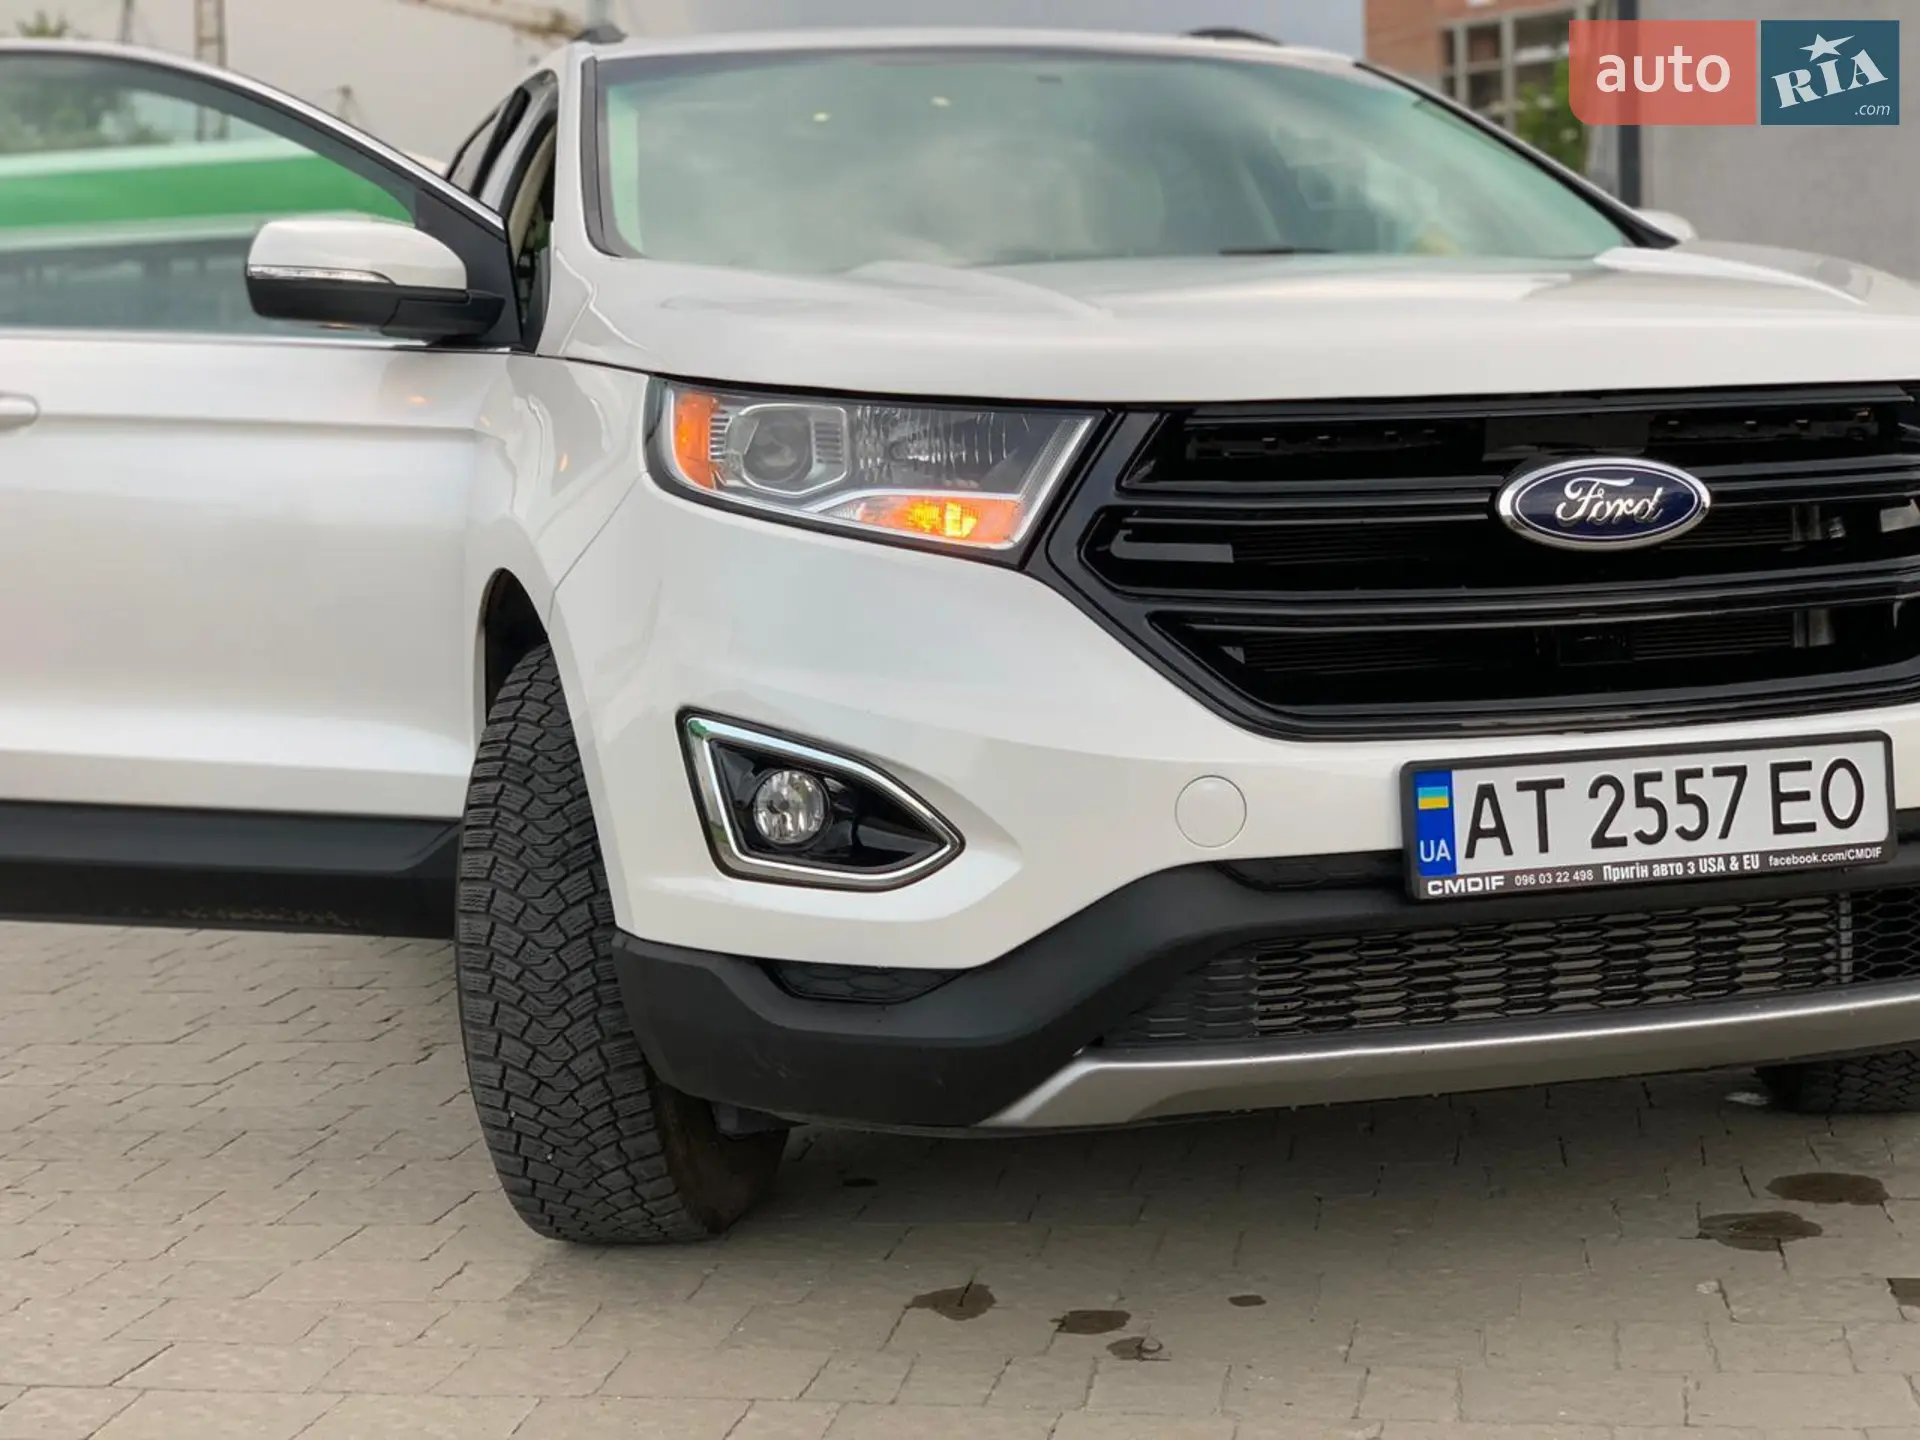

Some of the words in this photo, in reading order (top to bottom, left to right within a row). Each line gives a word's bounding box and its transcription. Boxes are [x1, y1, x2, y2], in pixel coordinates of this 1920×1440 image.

[1555, 477, 1664, 522] Ford
[1464, 778, 1565, 859] AT
[1588, 764, 1748, 849] 2557
[1769, 757, 1864, 836] EO
[1419, 838, 1452, 864] UA
[1768, 846, 1883, 867] facebook.com/CMDIF
[1514, 873, 1536, 887] 096
[1539, 872, 1553, 884] 03
[1556, 871, 1570, 883] 22
[1573, 869, 1594, 882] 498
[1602, 861, 1649, 882] Пригін
[1652, 863, 1683, 877] авто
[1699, 857, 1726, 874] USA
[1729, 856, 1740, 871] &
[1743, 854, 1760, 870] EU
[1427, 875, 1505, 895] CMDIF
